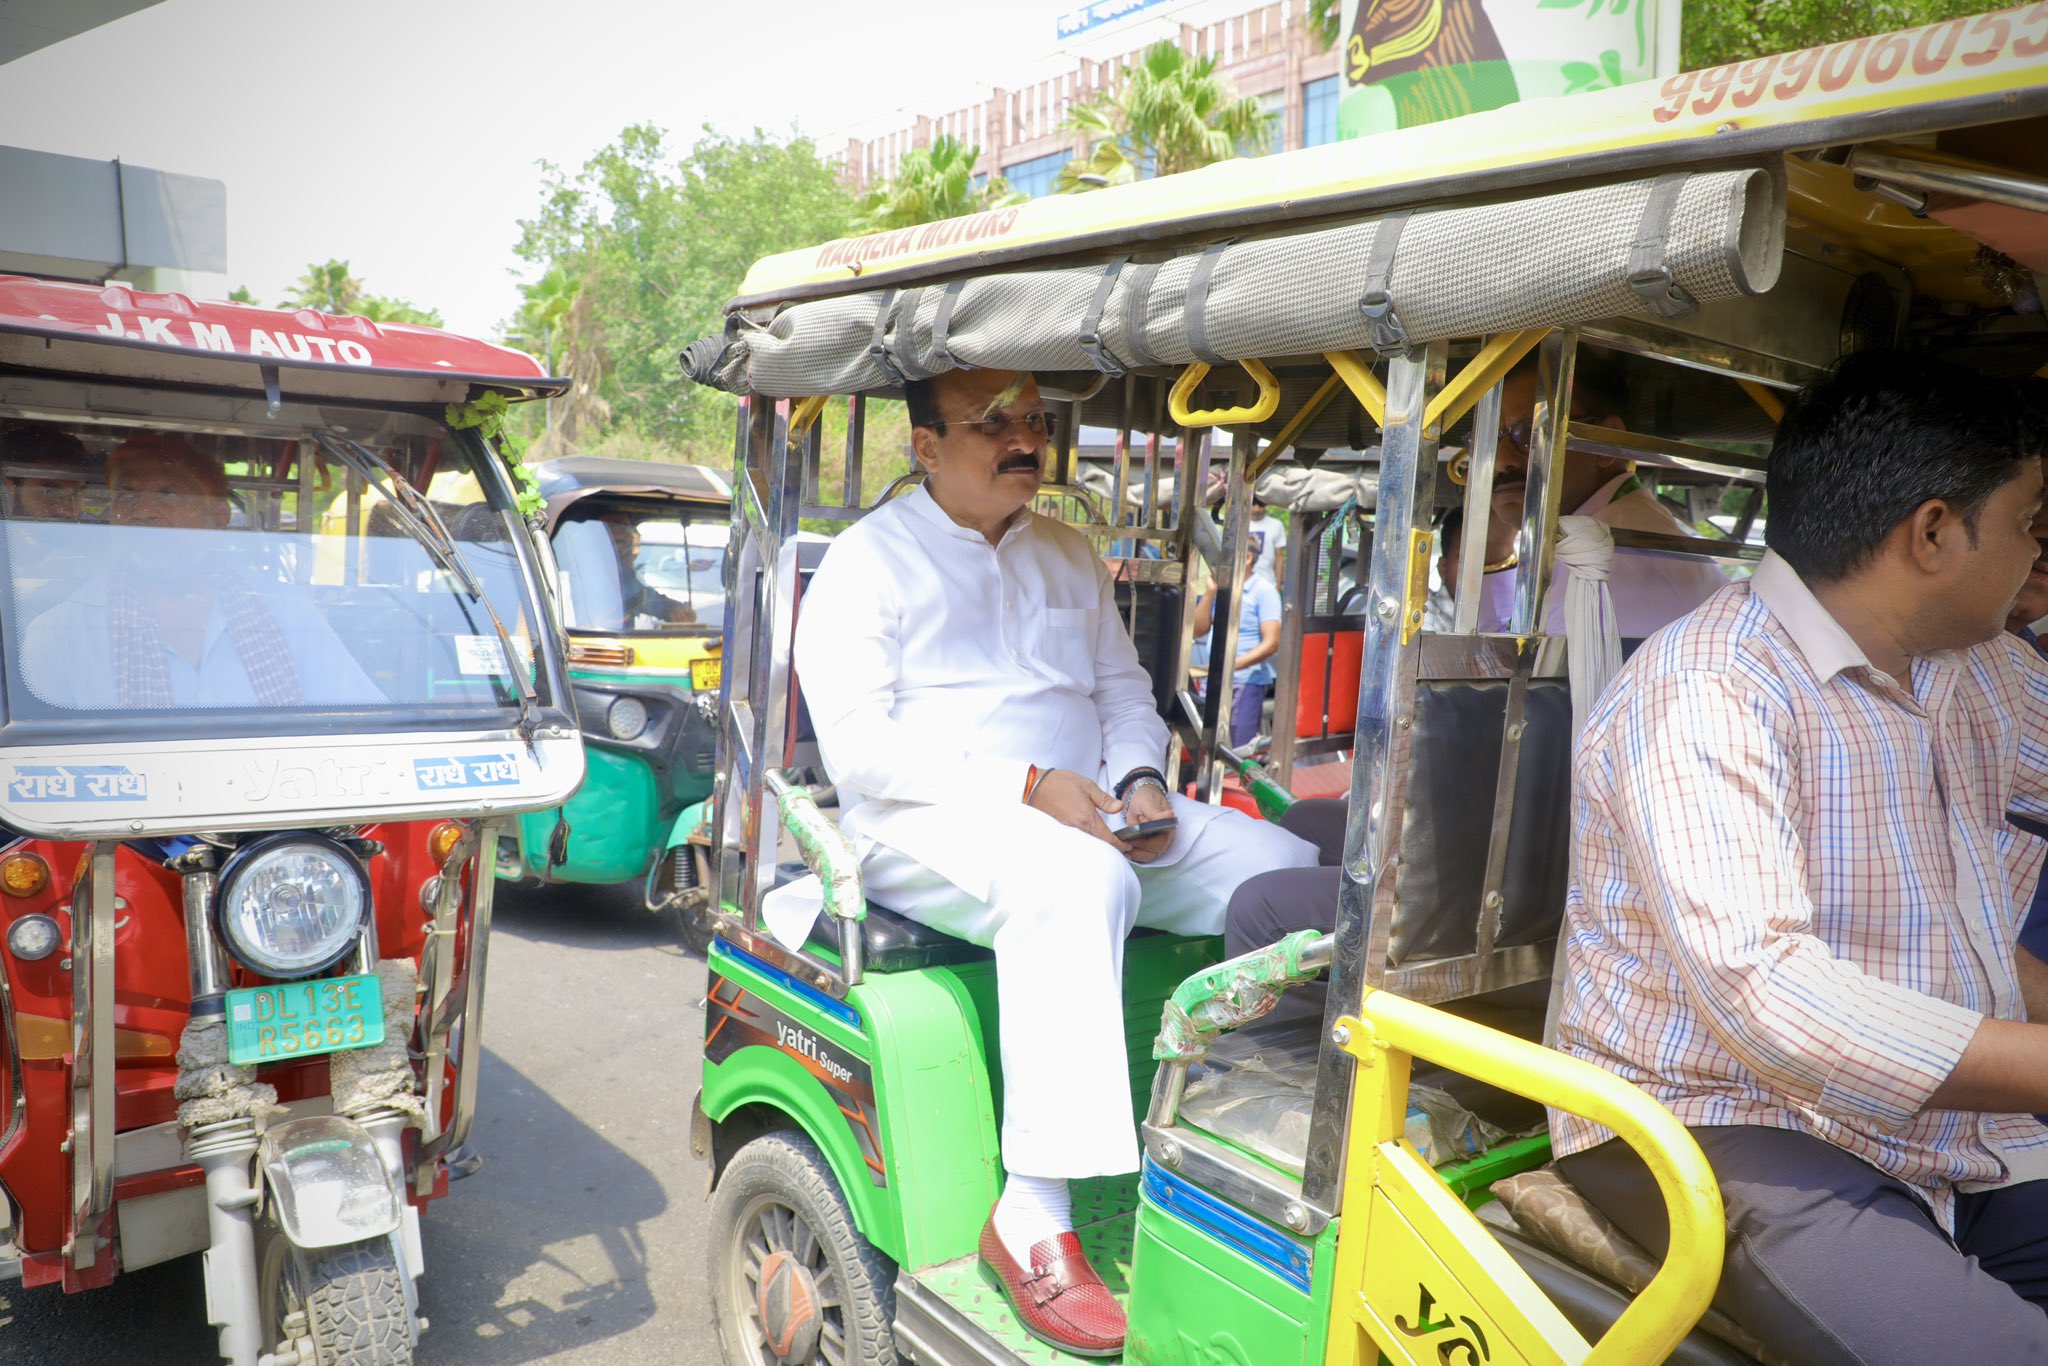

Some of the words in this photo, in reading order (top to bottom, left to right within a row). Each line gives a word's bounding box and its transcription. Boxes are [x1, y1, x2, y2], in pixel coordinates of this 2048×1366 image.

[189, 321, 235, 352] M
[250, 328, 373, 367] AUTO
[14, 766, 77, 799] राधे
[84, 766, 147, 797] राधे
[415, 757, 467, 787] राधे
[471, 754, 520, 783] राधे
[257, 1014, 365, 1056] R5663
[776, 1020, 818, 1062] yatri
[819, 1051, 853, 1083] Super
